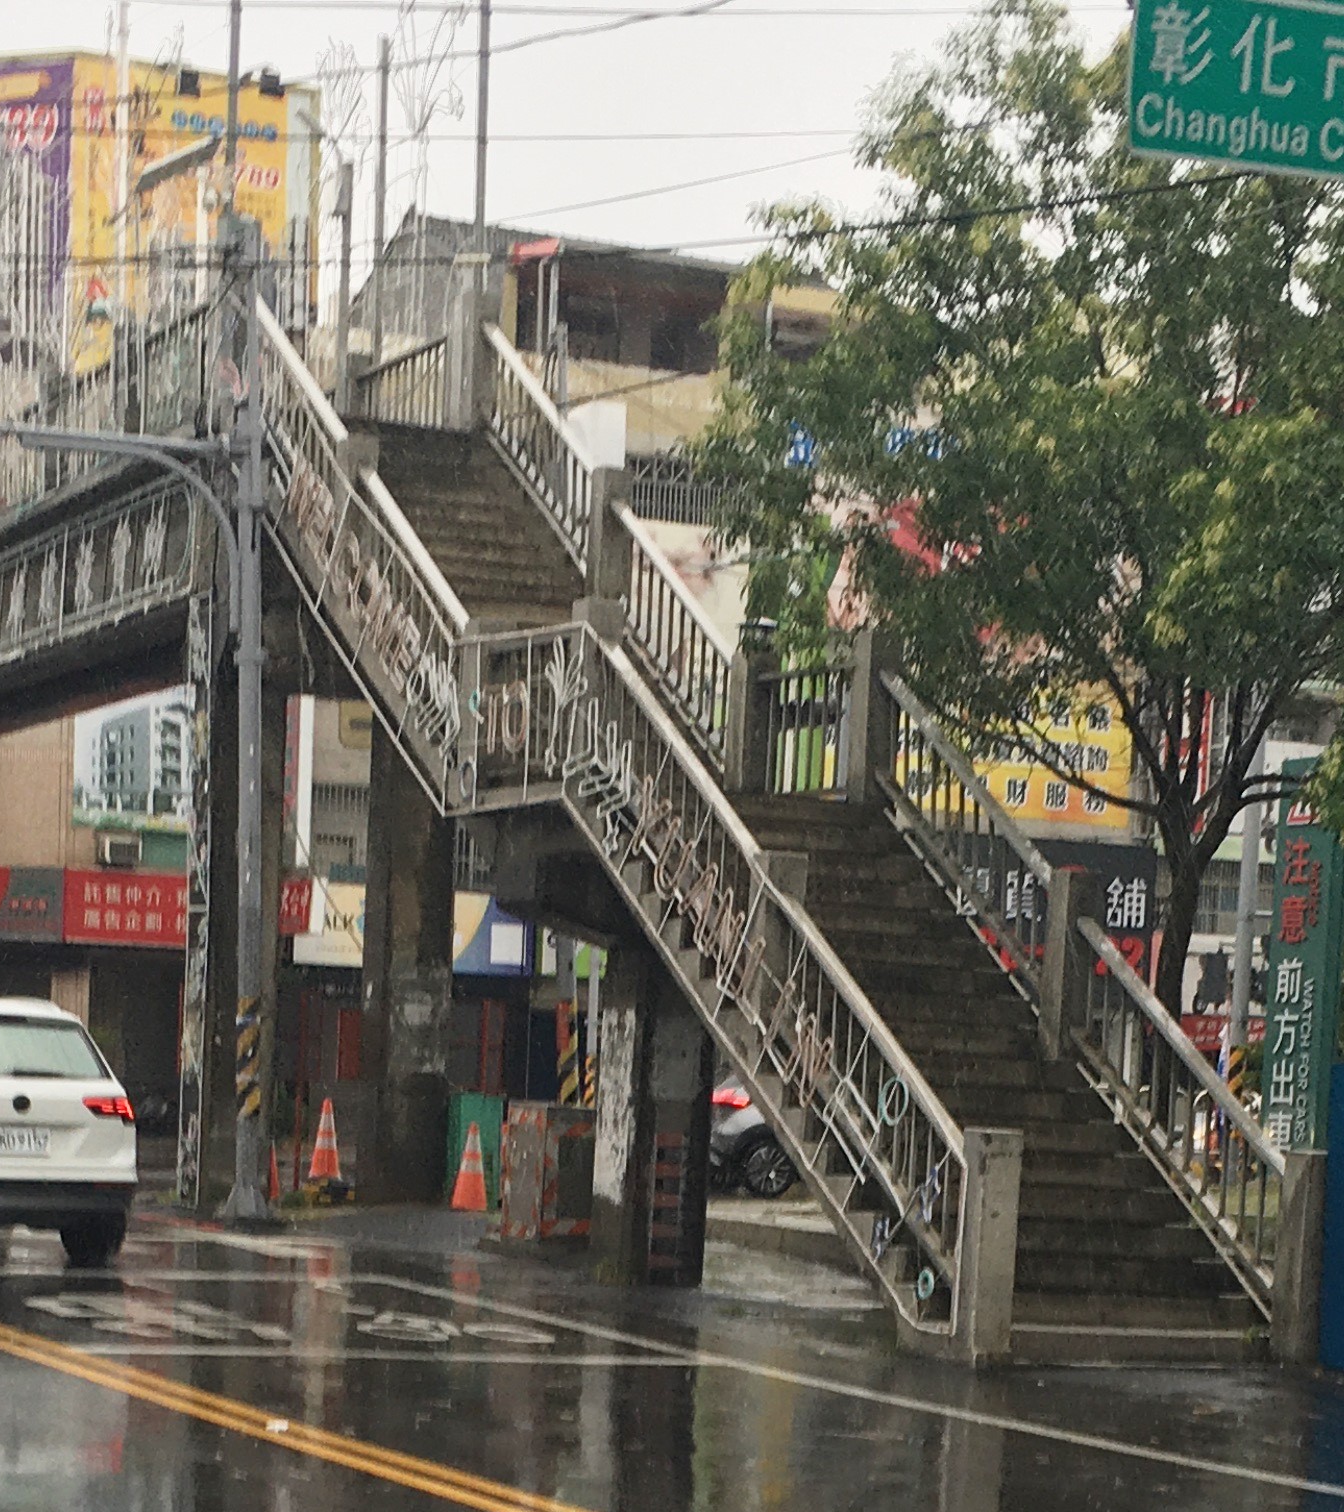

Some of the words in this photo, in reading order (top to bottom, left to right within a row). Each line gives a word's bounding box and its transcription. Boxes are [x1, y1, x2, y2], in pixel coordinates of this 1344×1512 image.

[1136, 92, 1310, 156] Changhua
[1277, 834, 1312, 946] 注意
[1299, 977, 1316, 1049] WATCH
[1268, 956, 1304, 1151] 前方出車
[1297, 1052, 1311, 1091] FOR
[1293, 1095, 1308, 1144] CARS
